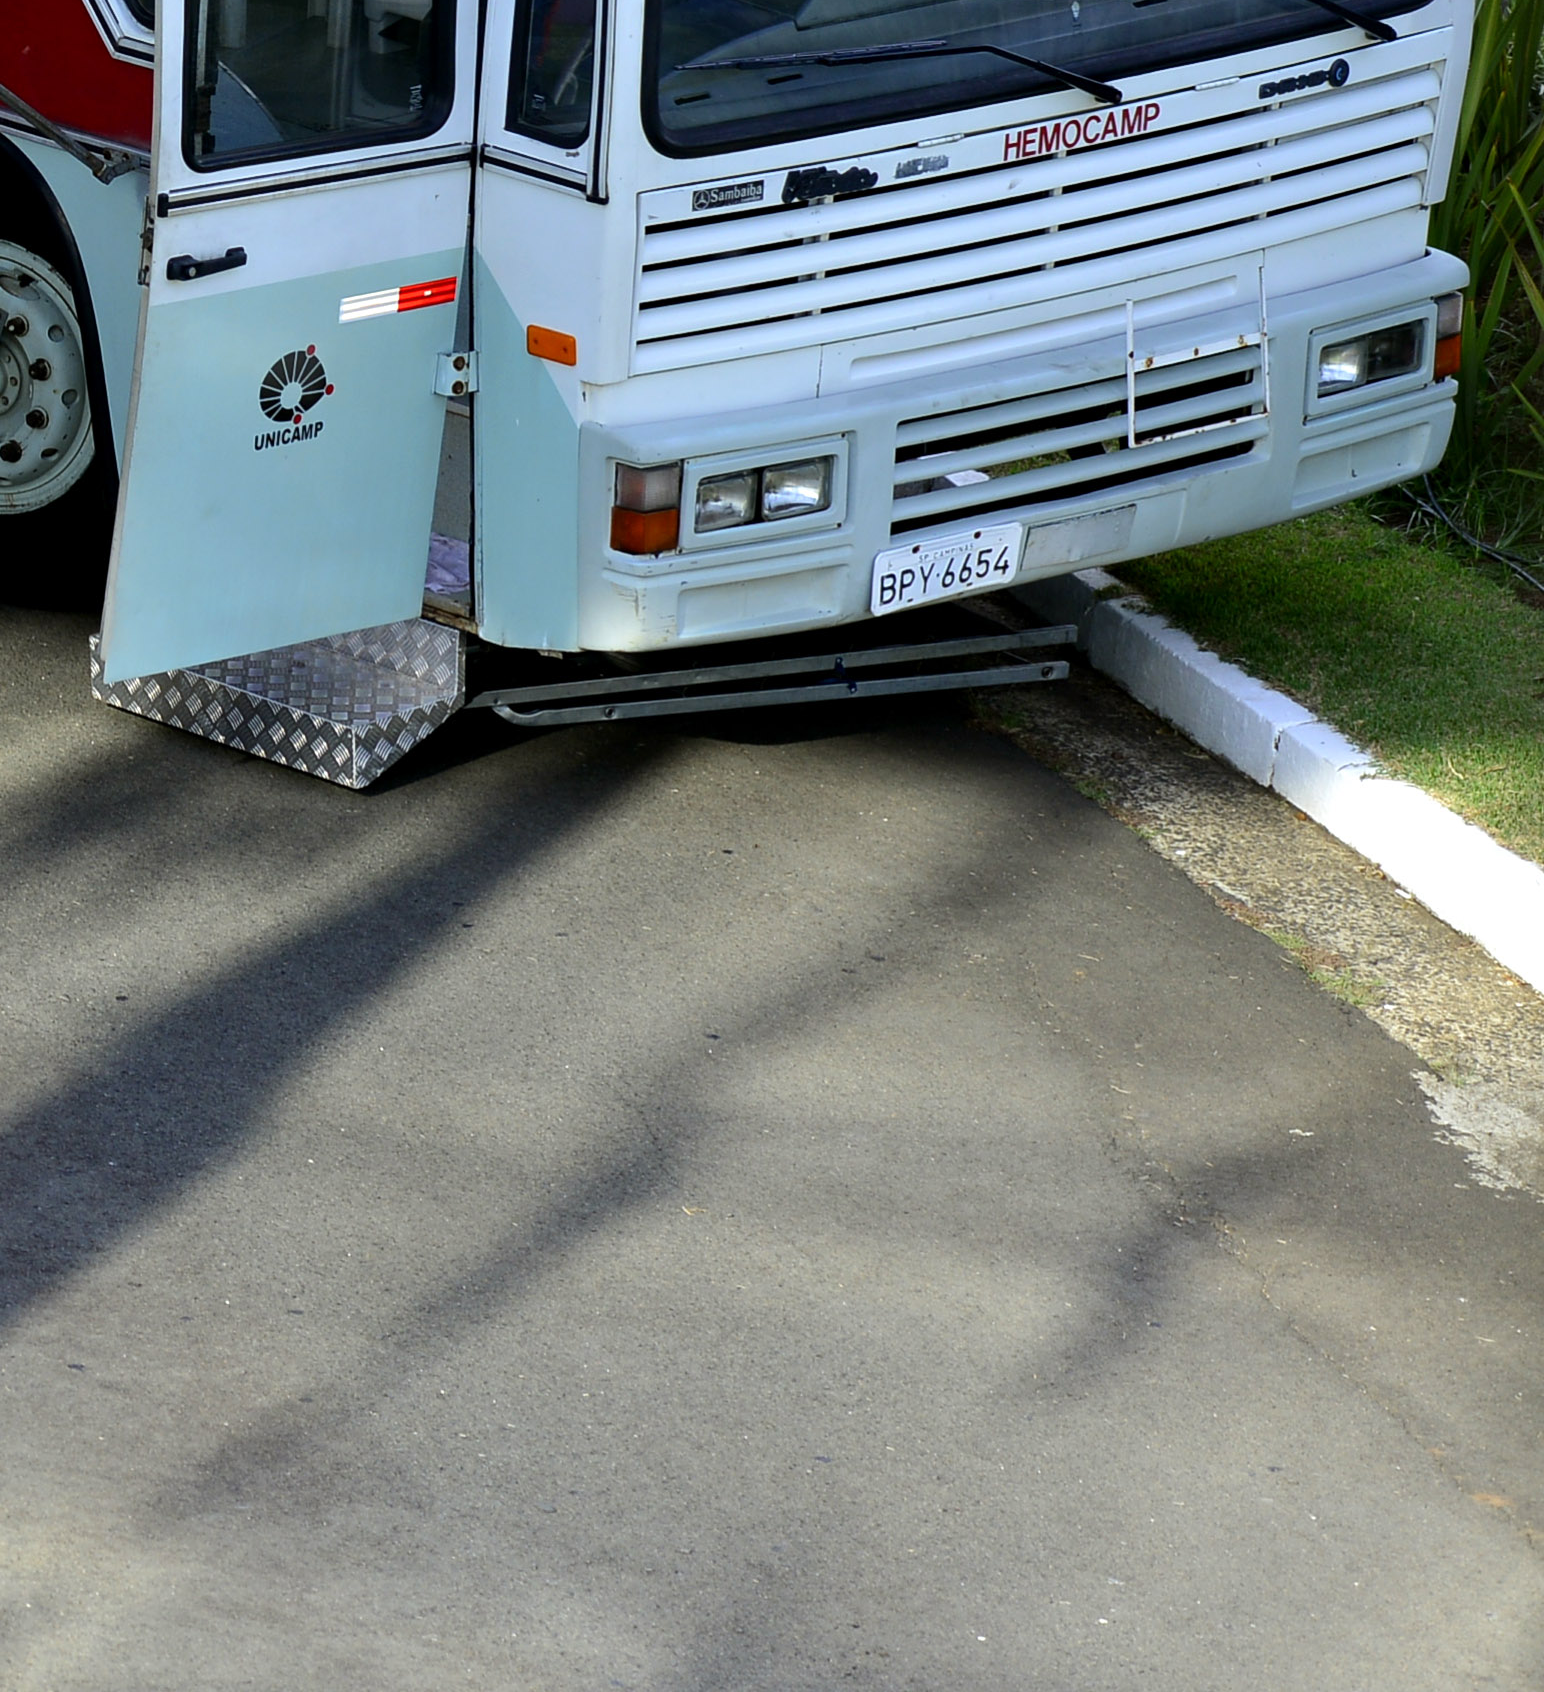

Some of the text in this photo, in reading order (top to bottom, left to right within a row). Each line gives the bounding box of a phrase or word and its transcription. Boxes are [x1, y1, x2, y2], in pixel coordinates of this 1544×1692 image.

[1003, 102, 1160, 161] HEMOCAMP
[711, 183, 763, 204] Sambaiba
[254, 421, 324, 451] UNICAMP
